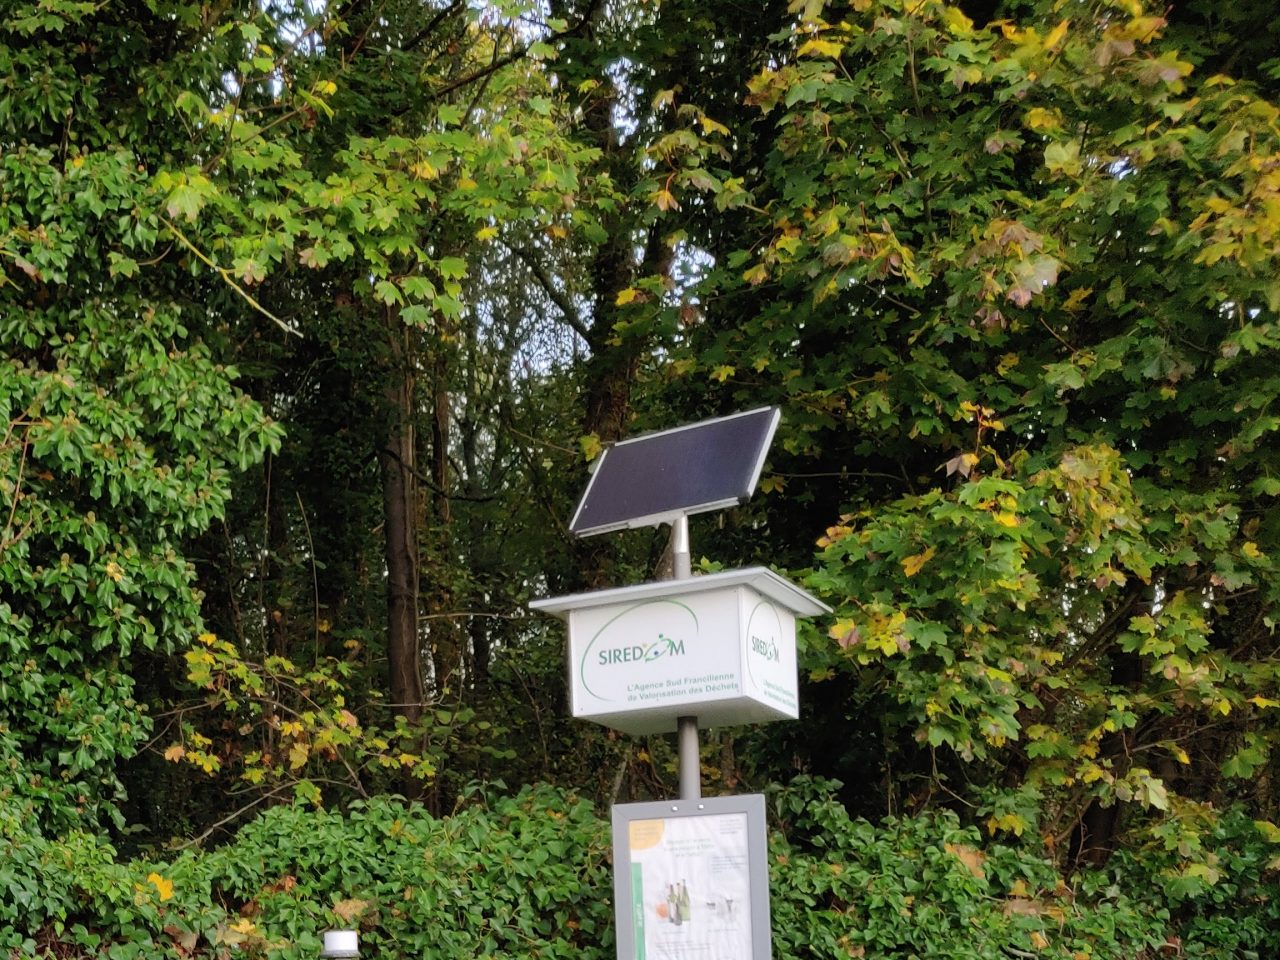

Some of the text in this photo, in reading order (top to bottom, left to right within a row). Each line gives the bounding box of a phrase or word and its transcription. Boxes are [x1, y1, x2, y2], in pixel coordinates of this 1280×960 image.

[666, 679, 682, 687] Sud
[684, 673, 735, 684] Francilienne
[639, 689, 687, 701] Valorisation
[688, 686, 703, 695] des
